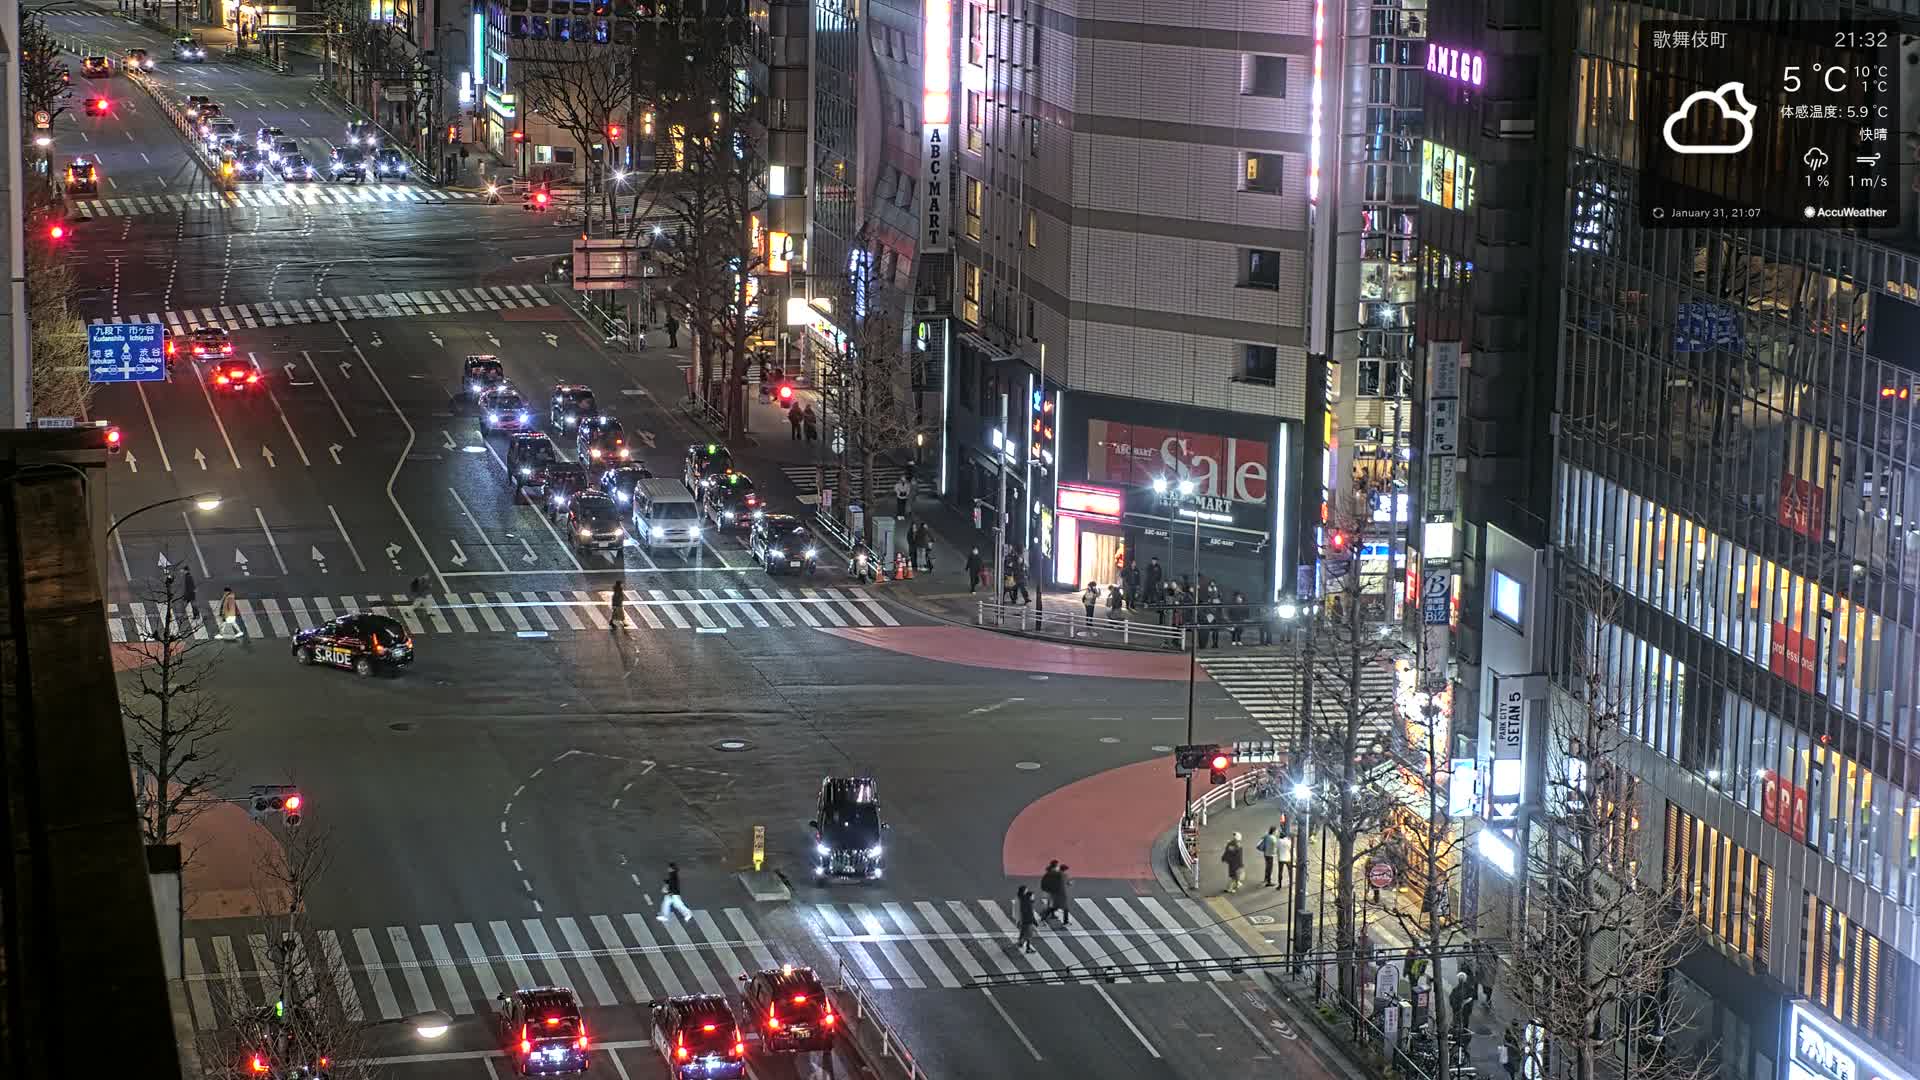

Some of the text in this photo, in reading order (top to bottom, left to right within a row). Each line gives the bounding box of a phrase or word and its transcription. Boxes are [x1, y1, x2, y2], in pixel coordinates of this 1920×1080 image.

[1427, 43, 1482, 86] AMIGO
[95, 326, 123, 336] 九段下
[92, 347, 160, 358] 池袋 渋谷
[139, 356, 162, 365] Shibuya
[1160, 436, 1268, 505] Sale
[1433, 514, 1445, 523] 7F
[315, 648, 352, 665] S.RIDE
[1498, 702, 1508, 740] PARK CITY
[1507, 692, 1521, 747] ISETAN 5
[1766, 780, 1804, 830] CPA
